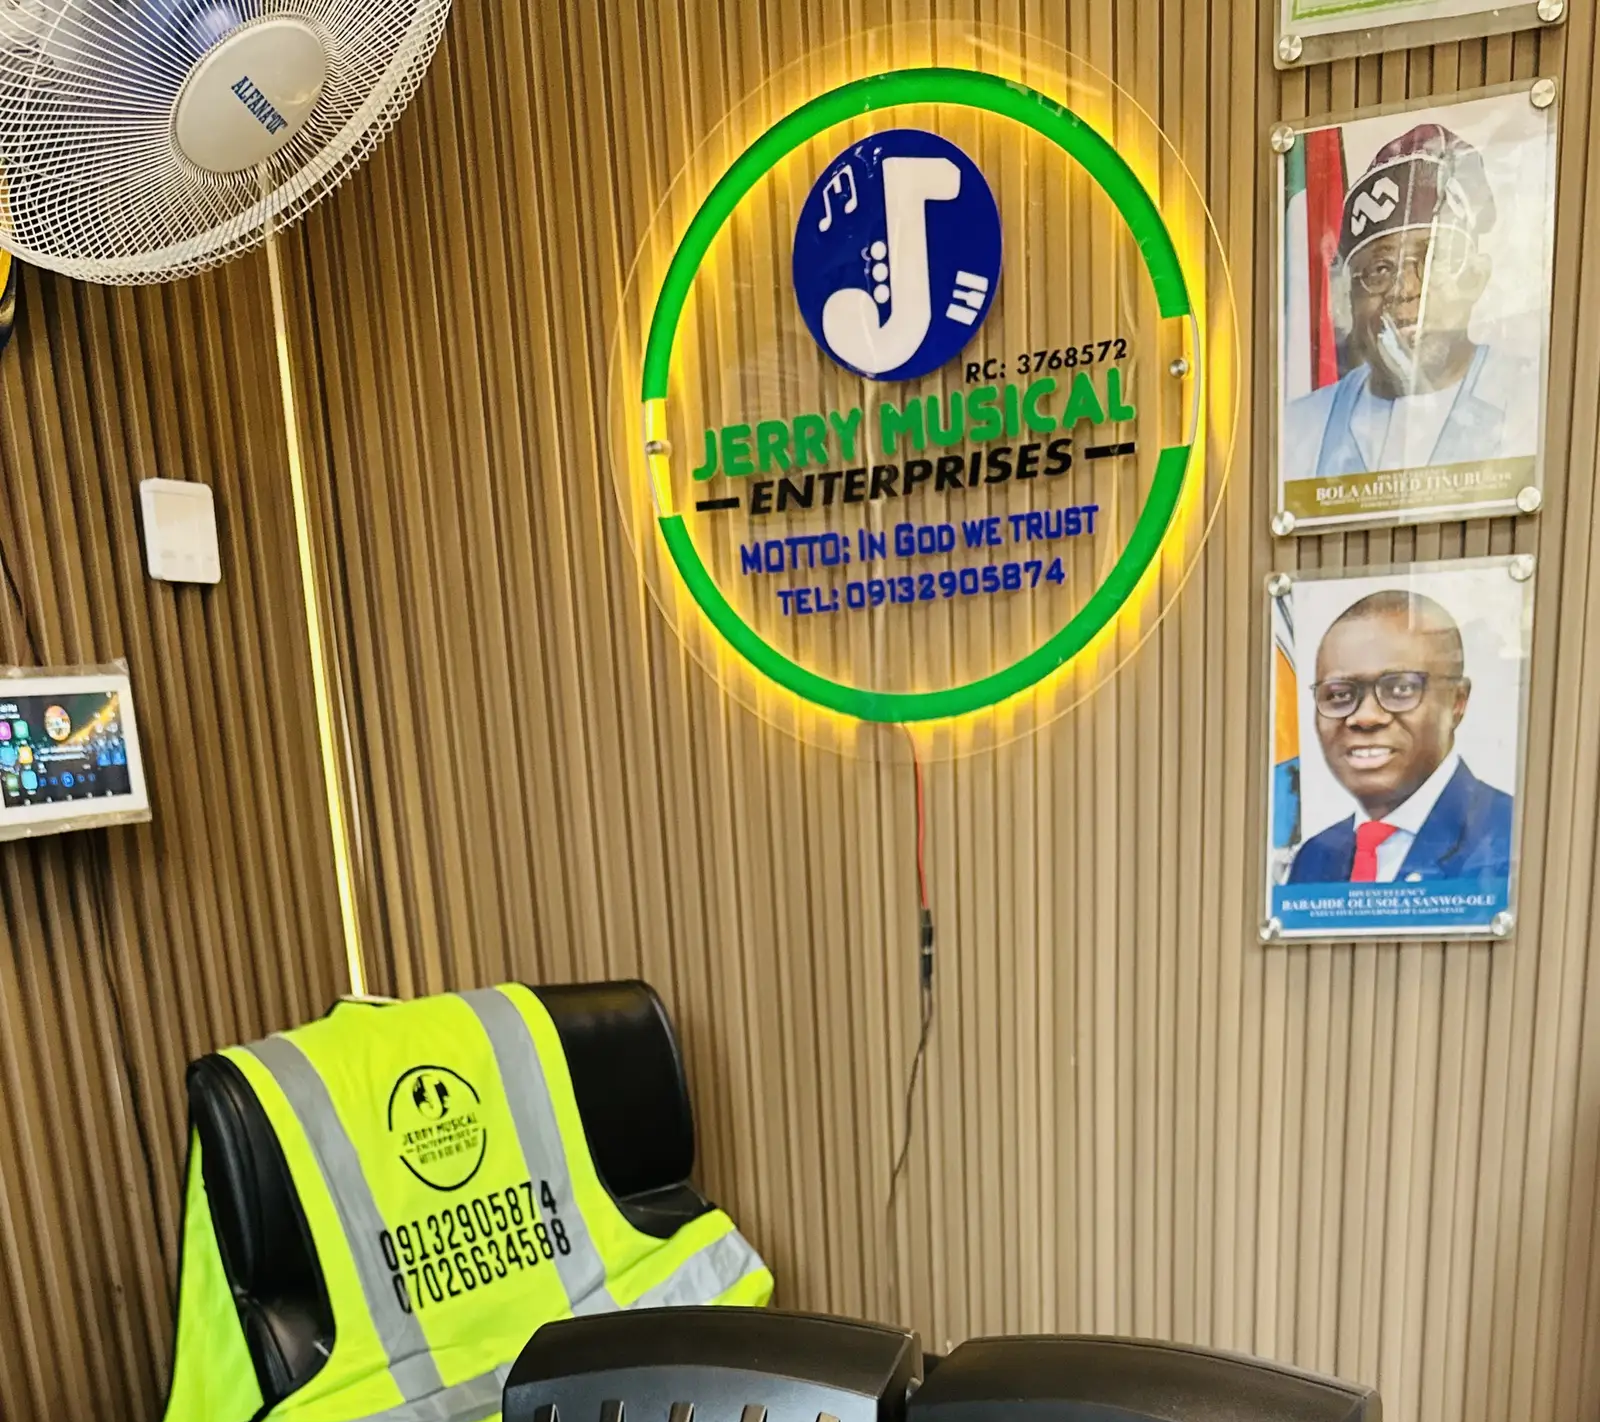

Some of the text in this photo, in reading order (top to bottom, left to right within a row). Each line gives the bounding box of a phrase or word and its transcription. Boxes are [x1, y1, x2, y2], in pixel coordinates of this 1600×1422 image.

[966, 338, 1128, 384] RC: 3768572
[692, 367, 1136, 481] JERRY MUSICAL
[750, 438, 1074, 516] ENTERPRISES
[1316, 487, 1359, 501] BOLA
[740, 532, 851, 576] MOTTO:
[1008, 505, 1099, 542] TRUST
[778, 557, 1065, 616] TEL: 09132905874
[1413, 894, 1496, 907] SANWO-OLU
[380, 1180, 557, 1271] 09132905874
[392, 1218, 571, 1313] 07026634588
